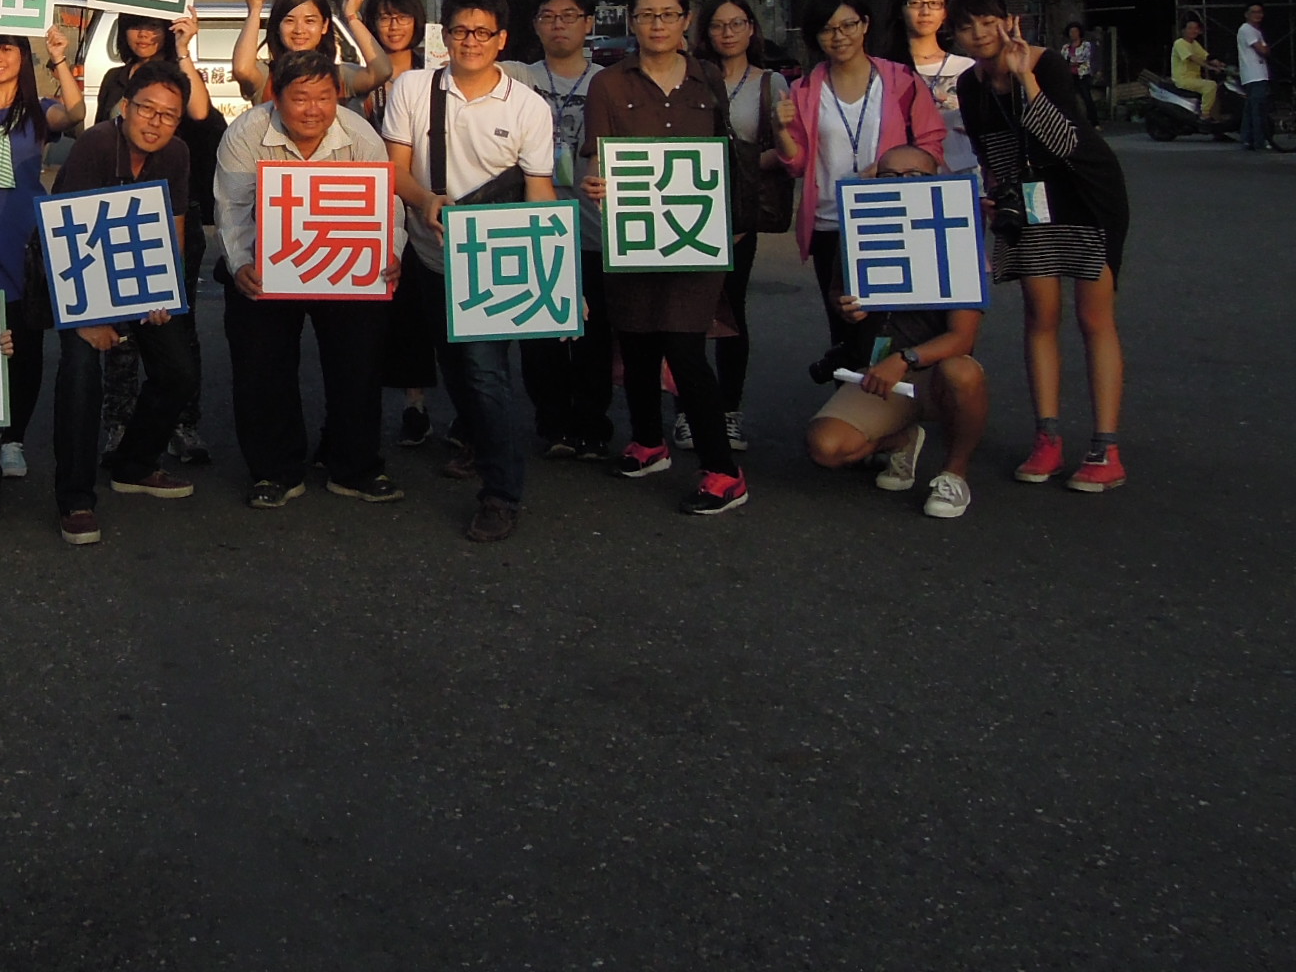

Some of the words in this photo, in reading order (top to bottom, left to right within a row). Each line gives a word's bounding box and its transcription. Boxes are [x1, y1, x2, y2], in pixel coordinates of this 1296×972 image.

[51, 196, 175, 317] 推
[268, 174, 384, 288] 場
[609, 150, 720, 259] 設
[849, 185, 969, 299] 計
[456, 214, 572, 328] 域
